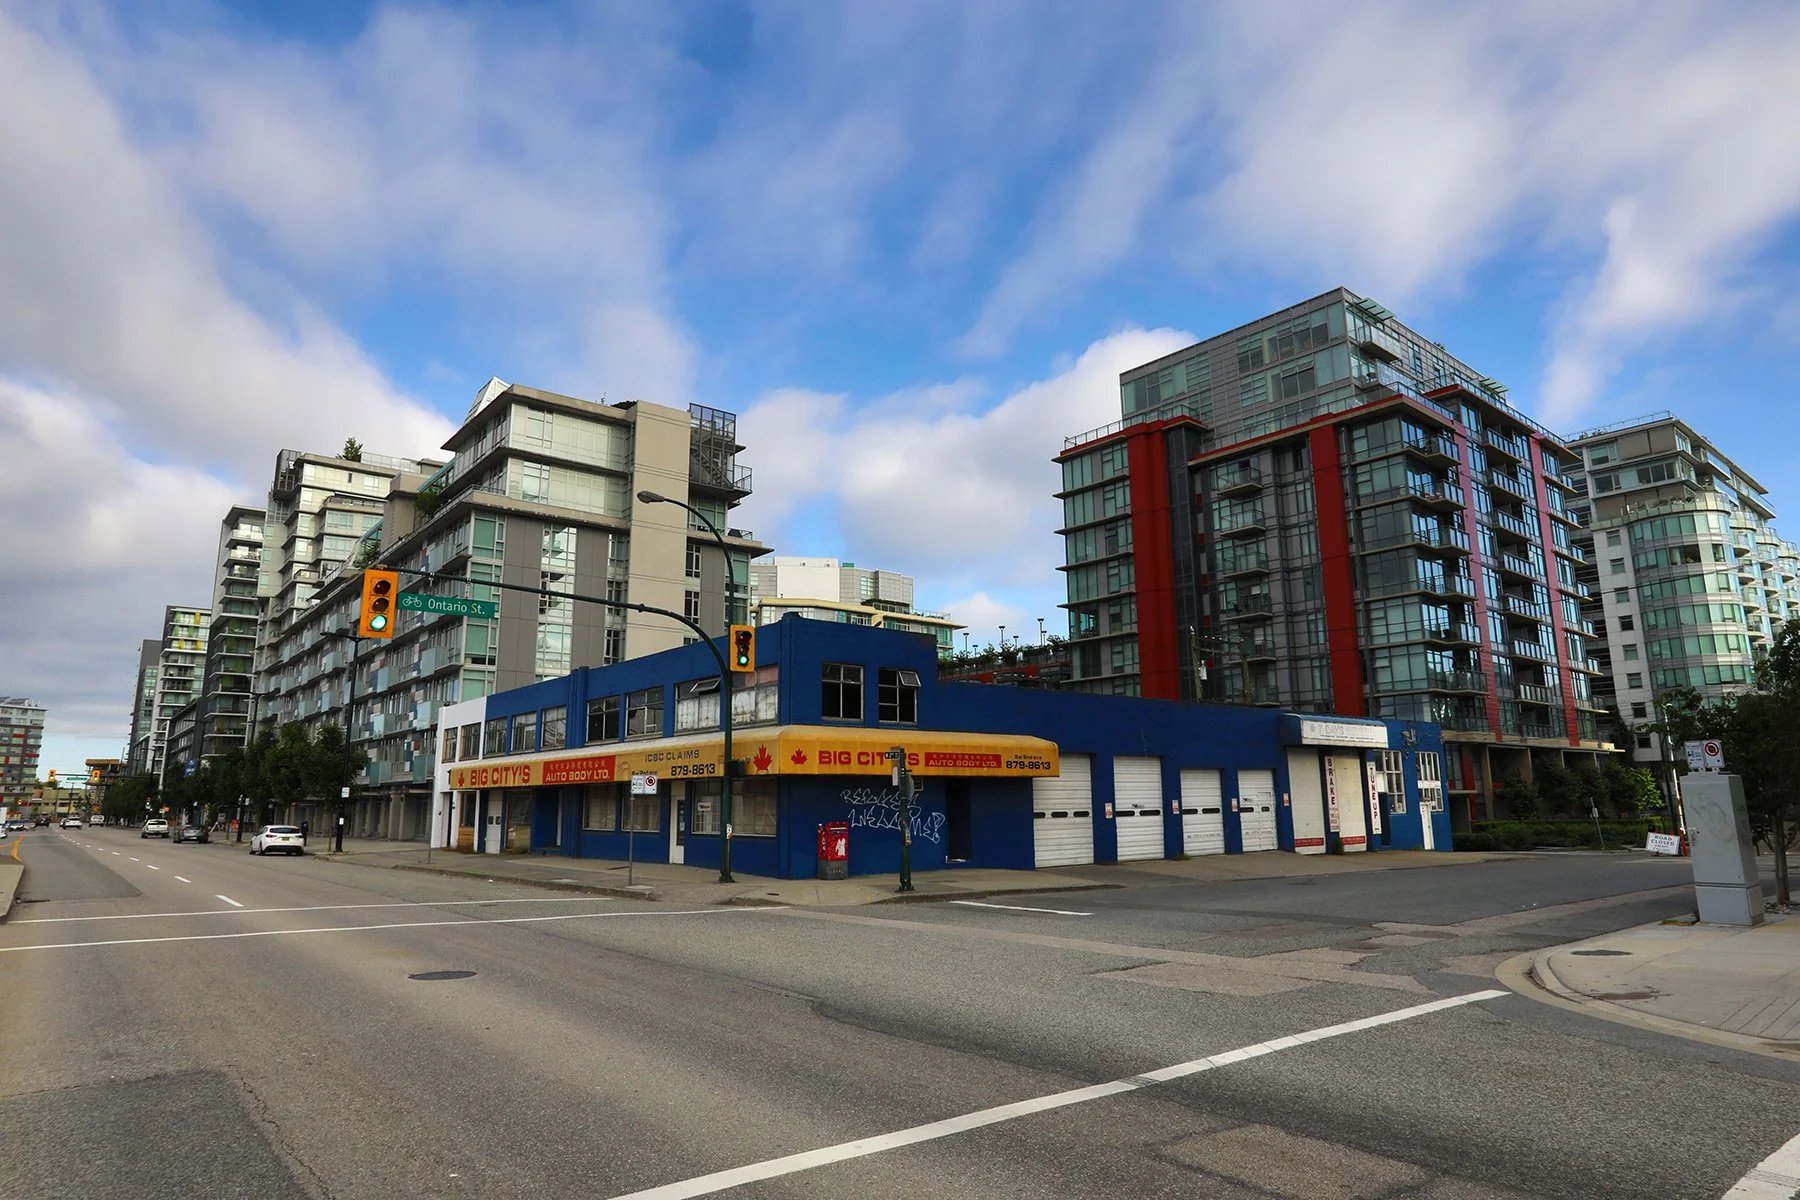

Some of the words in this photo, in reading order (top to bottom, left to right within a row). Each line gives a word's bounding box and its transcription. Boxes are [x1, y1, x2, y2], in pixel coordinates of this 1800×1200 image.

[428, 598, 467, 612] Ontario
[471, 603, 485, 614] St.
[1317, 725, 1322, 734] 7
[1325, 725, 1344, 735] DAYS
[645, 753, 664, 762] ICBC
[666, 750, 700, 760] CLAIMS
[818, 750, 852, 765] BIG
[470, 769, 488, 786] BIG
[491, 765, 531, 785] CITY'S
[545, 771, 567, 782] AUTO
[568, 770, 592, 781] BODY
[593, 769, 610, 780] LTD.
[1327, 758, 1336, 805] BRAKE
[1650, 838, 1675, 846] CLOSED
